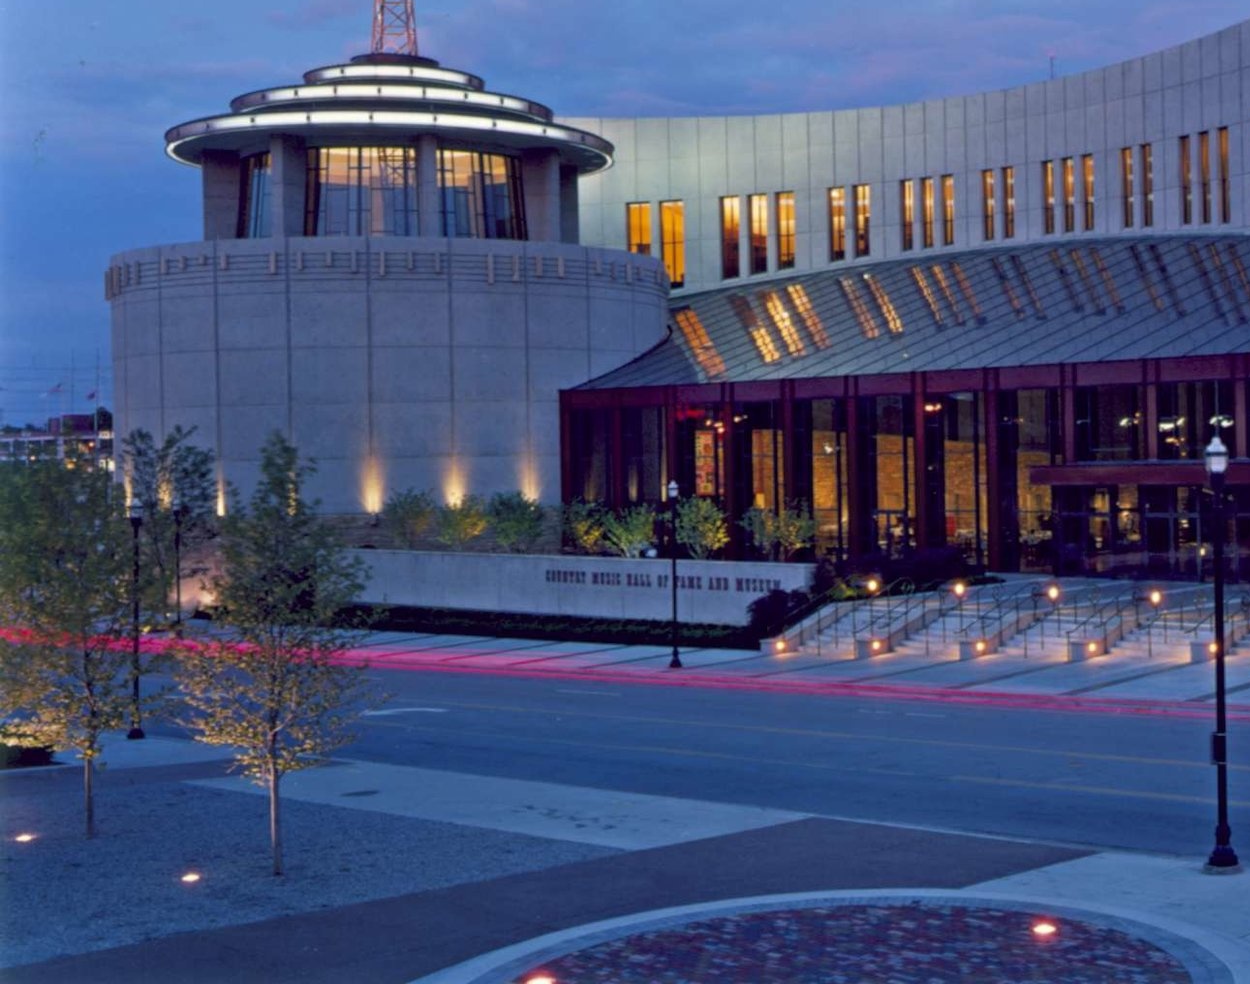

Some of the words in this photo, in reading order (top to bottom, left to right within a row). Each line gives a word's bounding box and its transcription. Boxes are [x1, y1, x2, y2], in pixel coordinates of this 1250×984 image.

[545, 569, 586, 583] COUNTRY
[592, 572, 621, 585] MUSIC
[626, 573, 651, 587] HALL
[657, 574, 668, 588] OF
[708, 577, 729, 591] AND
